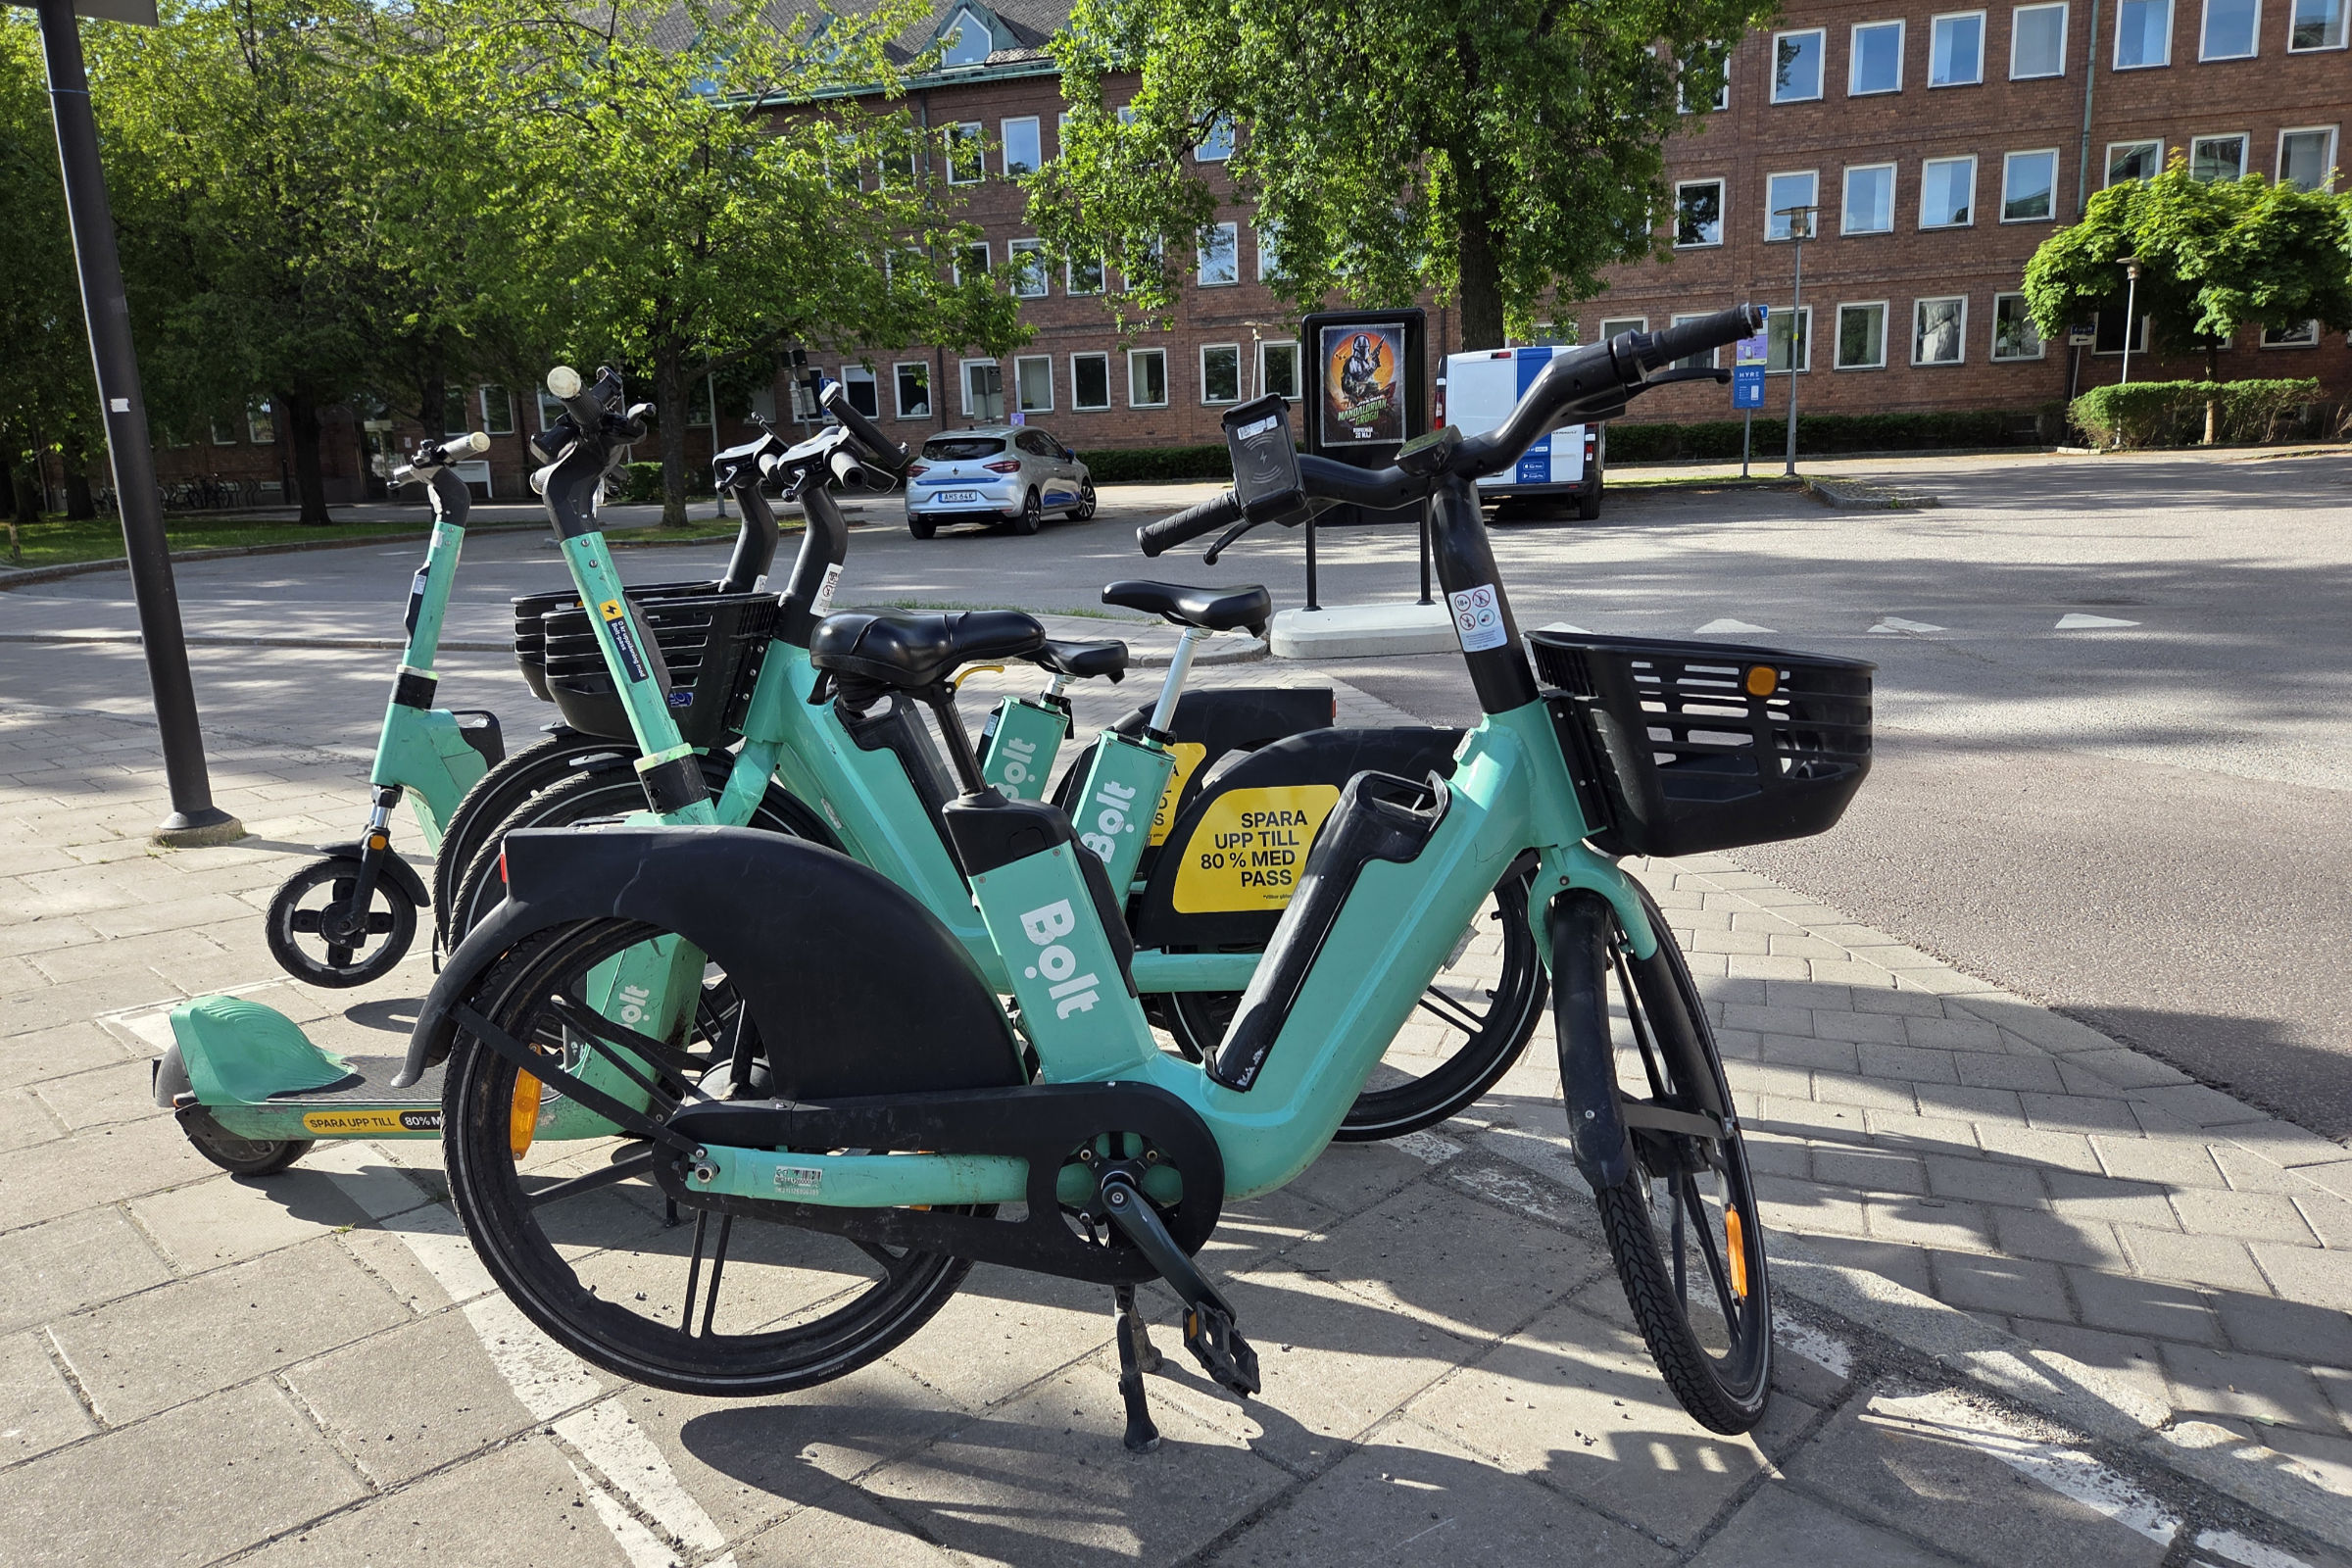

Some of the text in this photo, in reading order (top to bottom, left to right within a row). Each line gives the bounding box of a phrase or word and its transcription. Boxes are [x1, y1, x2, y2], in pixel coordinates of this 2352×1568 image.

[1337, 399, 1387, 421] MANDALORIAN
[1355, 411, 1379, 426] GROGU
[1081, 781, 1136, 863] Bolt
[1241, 809, 1308, 829] SPARA
[1215, 830, 1299, 849] UPP TILL
[1201, 850, 1296, 870] 80 % MED
[1241, 870, 1292, 887] PASS
[1019, 898, 1100, 1019] Bolt
[619, 985, 650, 1030] olt
[309, 1118, 346, 1129] SPARA
[346, 1118, 369, 1127] UPP
[371, 1117, 395, 1126] TILL
[404, 1117, 430, 1126] 80%
